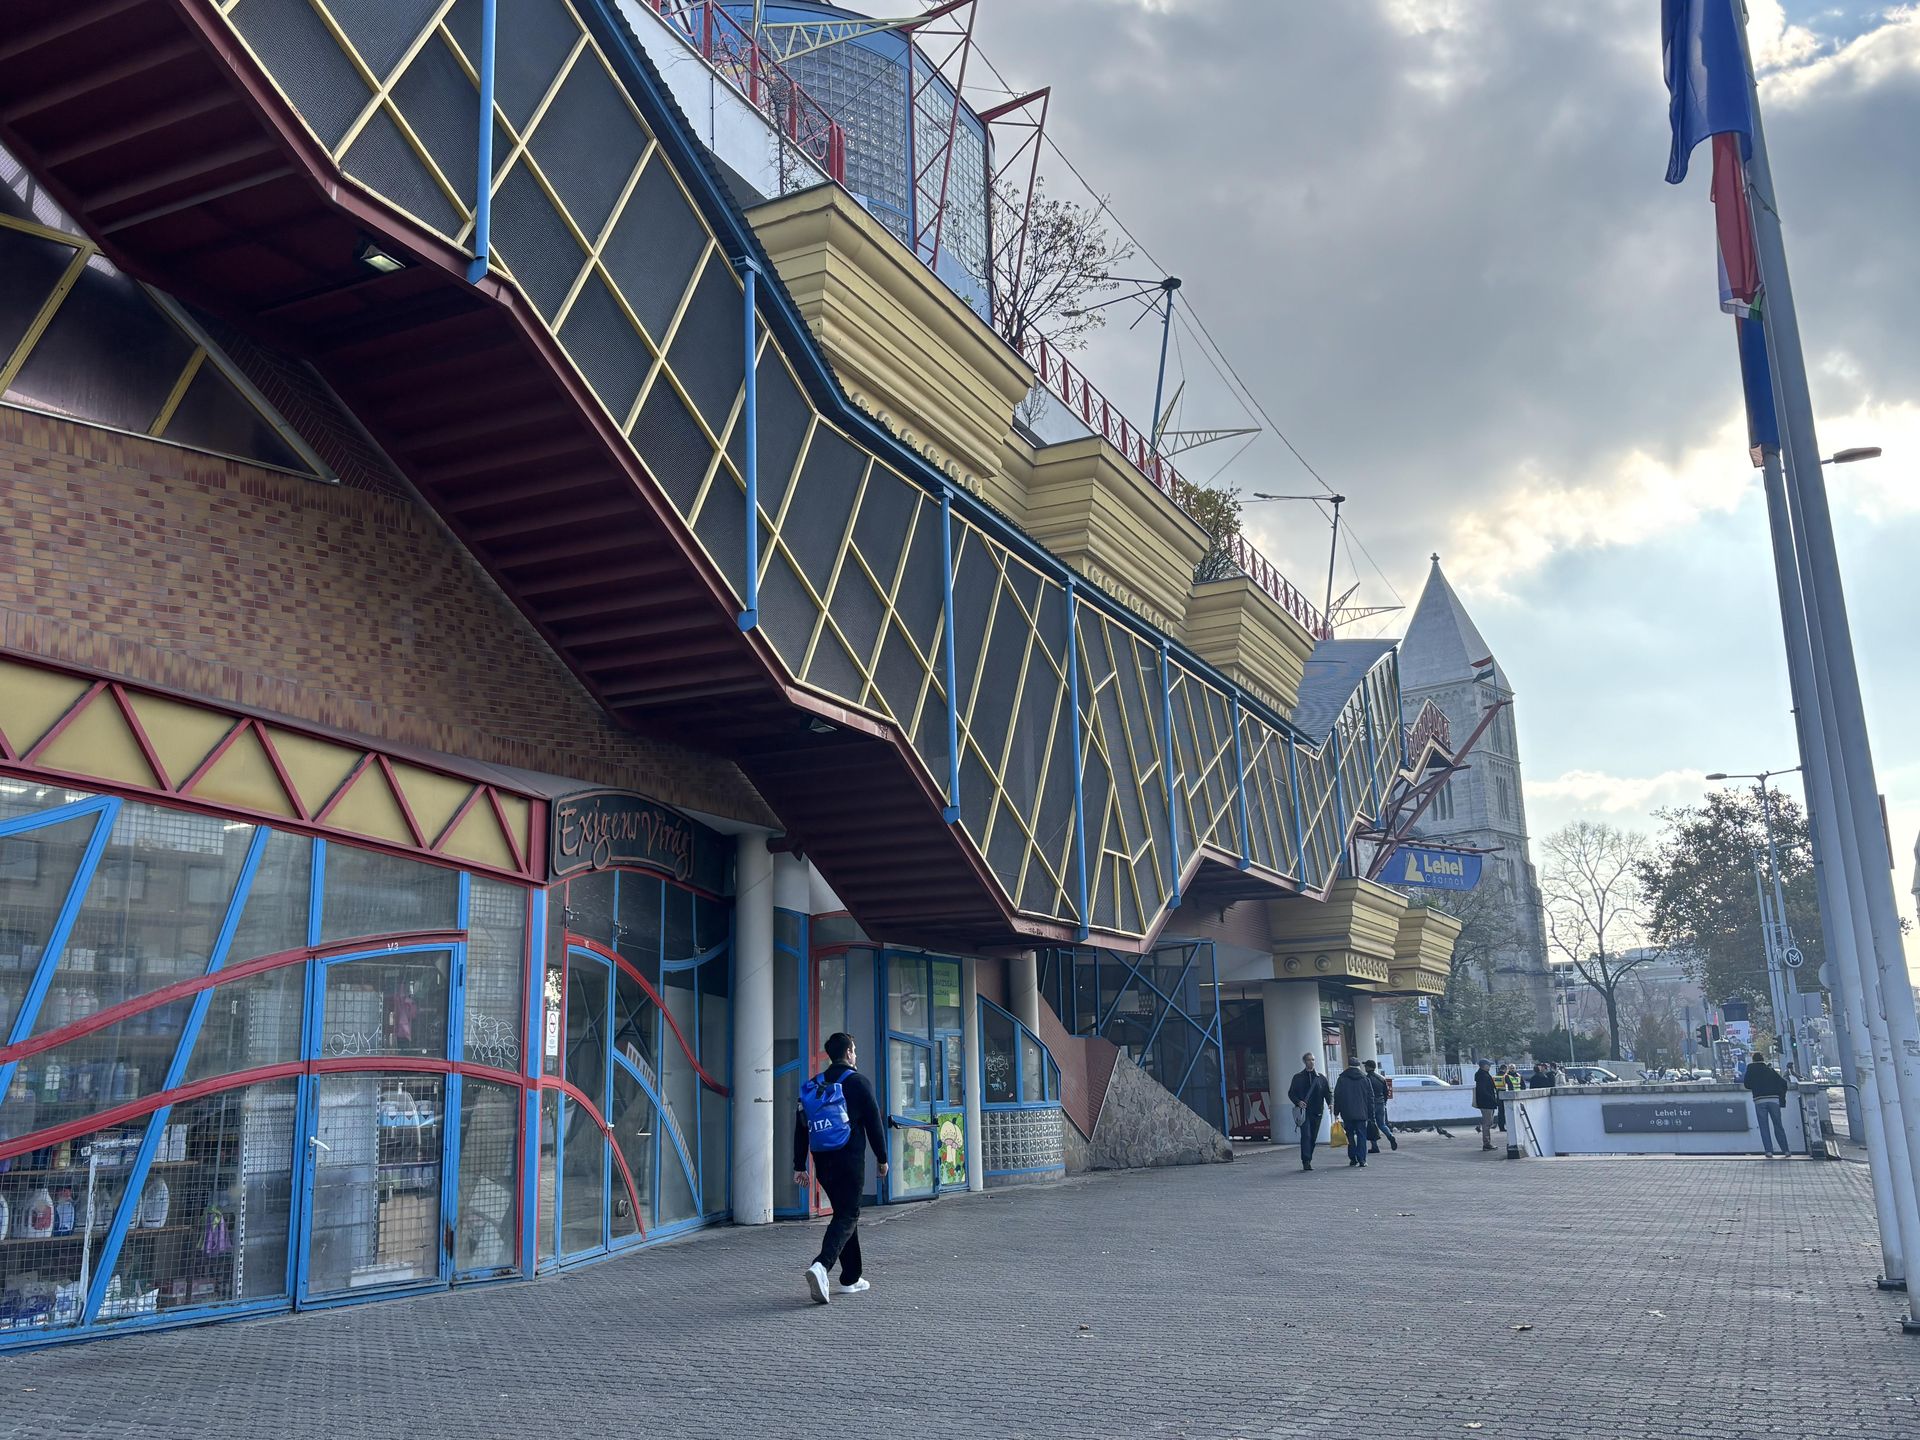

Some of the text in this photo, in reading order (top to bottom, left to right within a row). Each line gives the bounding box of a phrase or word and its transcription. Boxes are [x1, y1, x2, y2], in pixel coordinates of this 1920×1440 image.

[641, 810, 690, 882] Virág
[1423, 854, 1464, 877] Lehel
[387, 942, 399, 951] V3
[1655, 1109, 1691, 1117] Lehel tér
